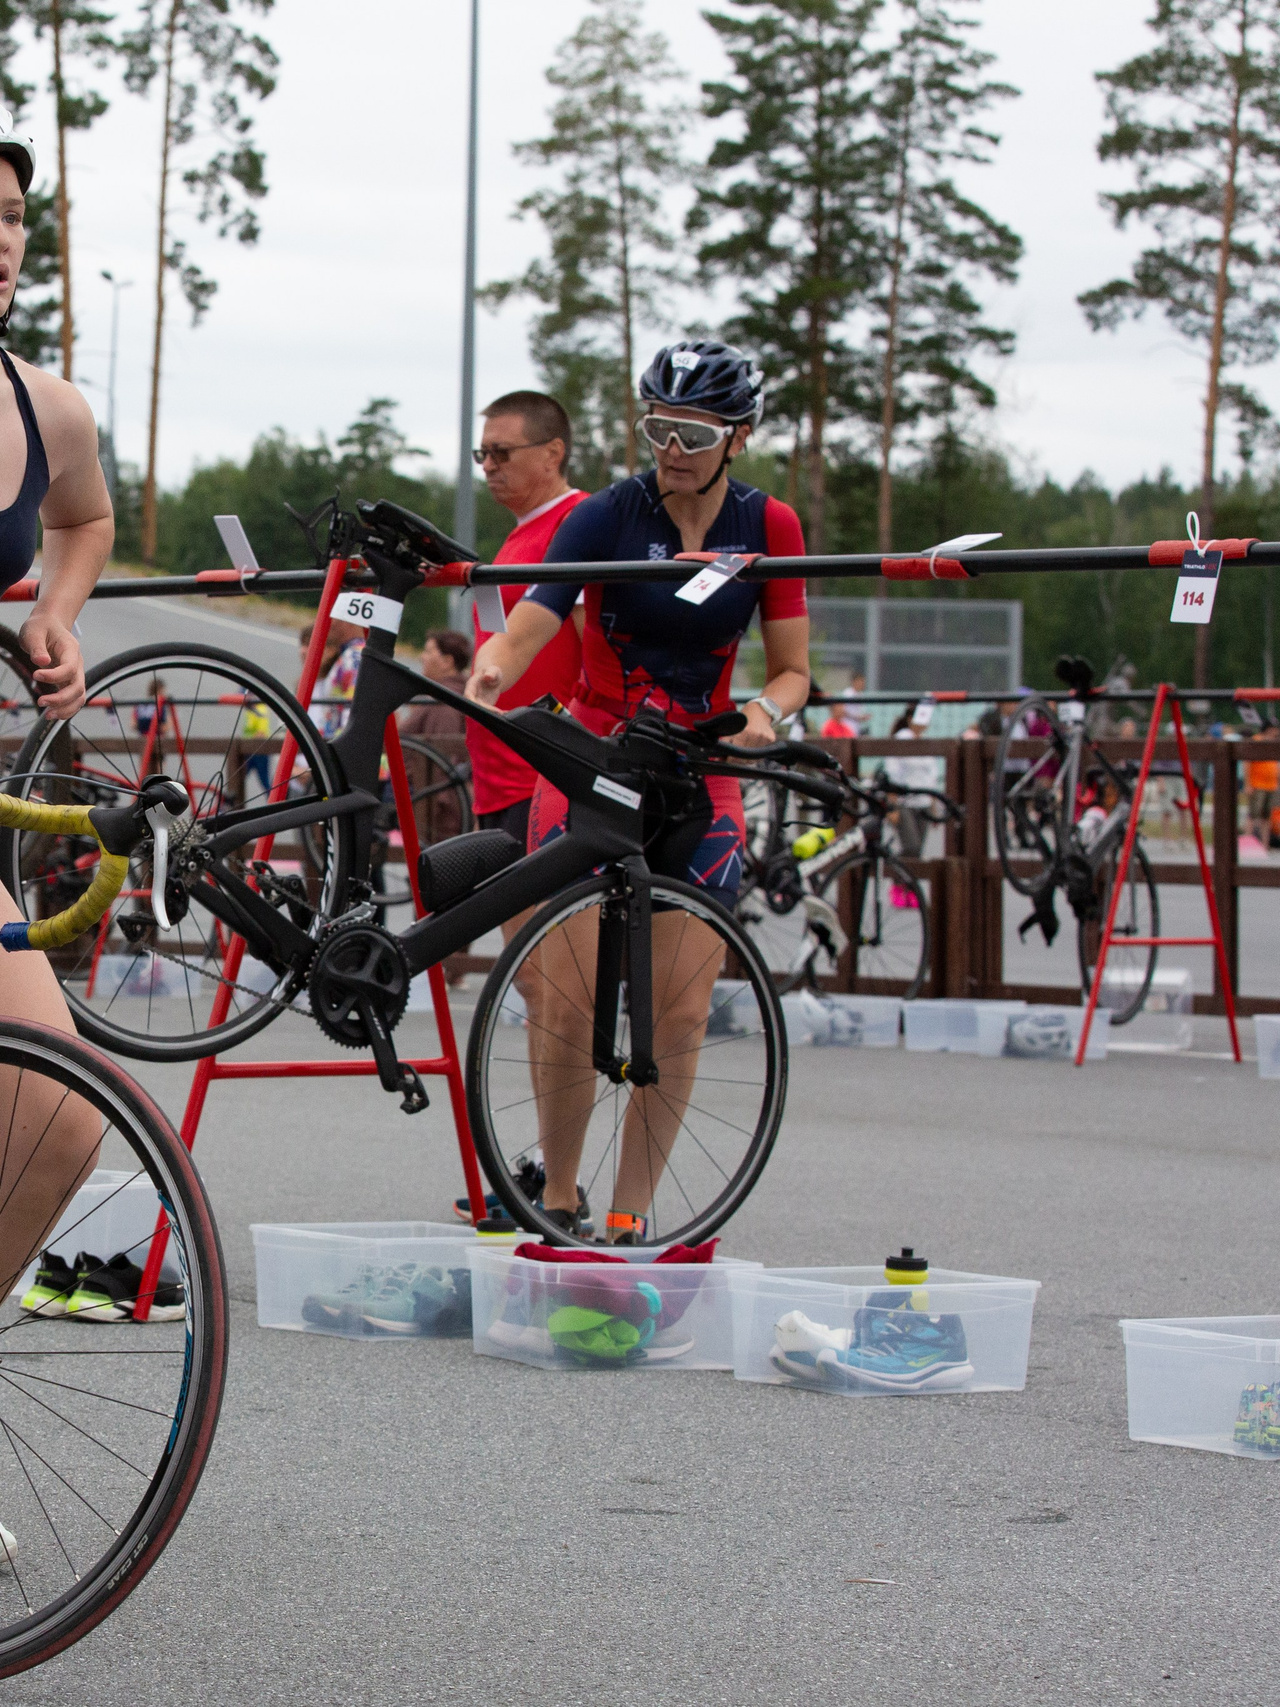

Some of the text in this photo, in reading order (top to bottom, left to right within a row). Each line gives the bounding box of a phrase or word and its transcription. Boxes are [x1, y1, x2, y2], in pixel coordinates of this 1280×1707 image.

[692, 578, 711, 592] 74
[1182, 590, 1205, 607] 114
[346, 598, 375, 620] 56
